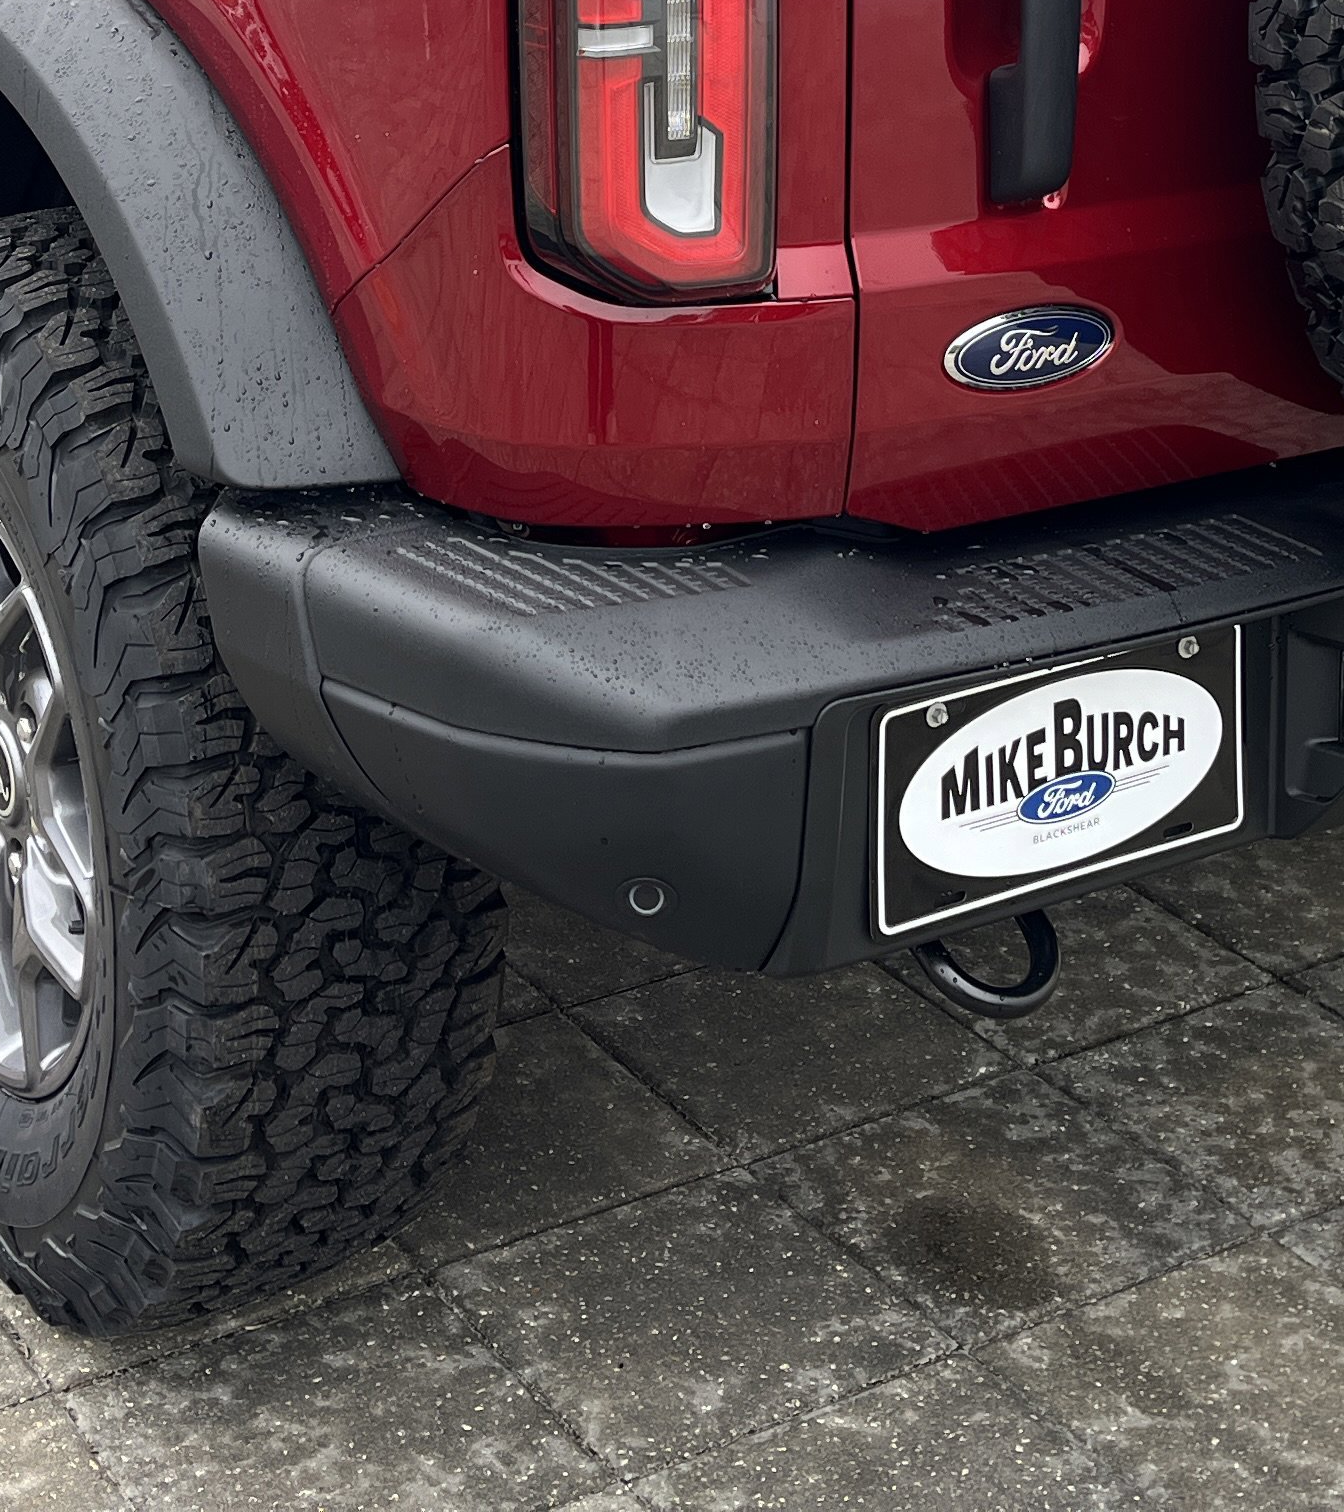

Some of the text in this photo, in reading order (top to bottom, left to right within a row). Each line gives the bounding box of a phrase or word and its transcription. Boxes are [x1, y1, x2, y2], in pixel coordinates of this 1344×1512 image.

[989, 325, 1079, 376] Ford
[940, 697, 1186, 820] MIKE BURCH
[1037, 782, 1096, 819] Ford
[1032, 817, 1100, 844] BLACKSHEAR
